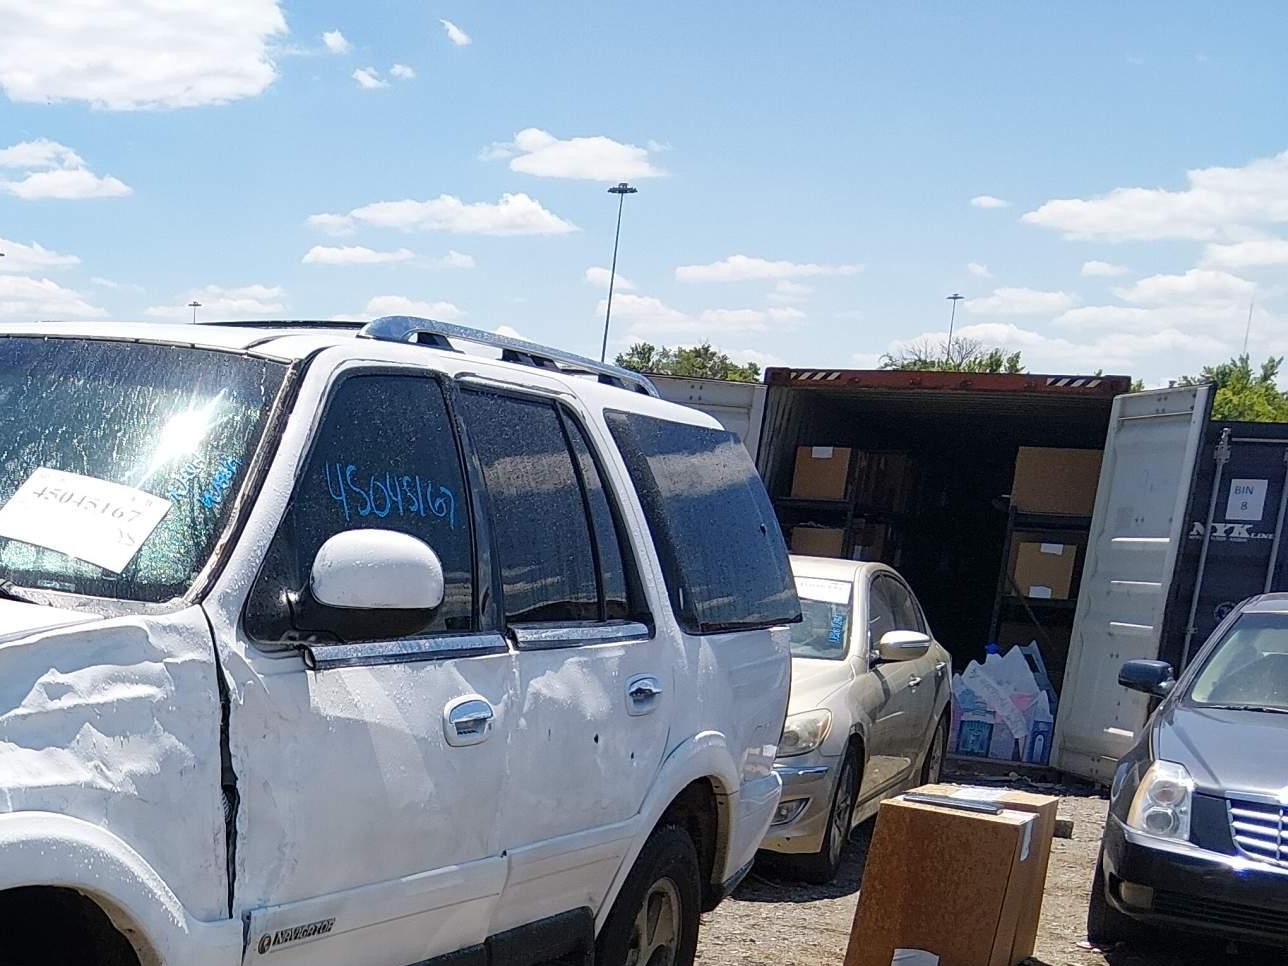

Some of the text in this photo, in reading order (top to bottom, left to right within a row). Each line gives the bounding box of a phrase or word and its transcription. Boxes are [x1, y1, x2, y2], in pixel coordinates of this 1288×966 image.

[324, 460, 455, 530] 45045167
[1234, 485, 1254, 495] BIN
[32, 485, 142, 523] 45045167
[1240, 501, 1248, 511] 8
[1189, 521, 1253, 537] NYK
